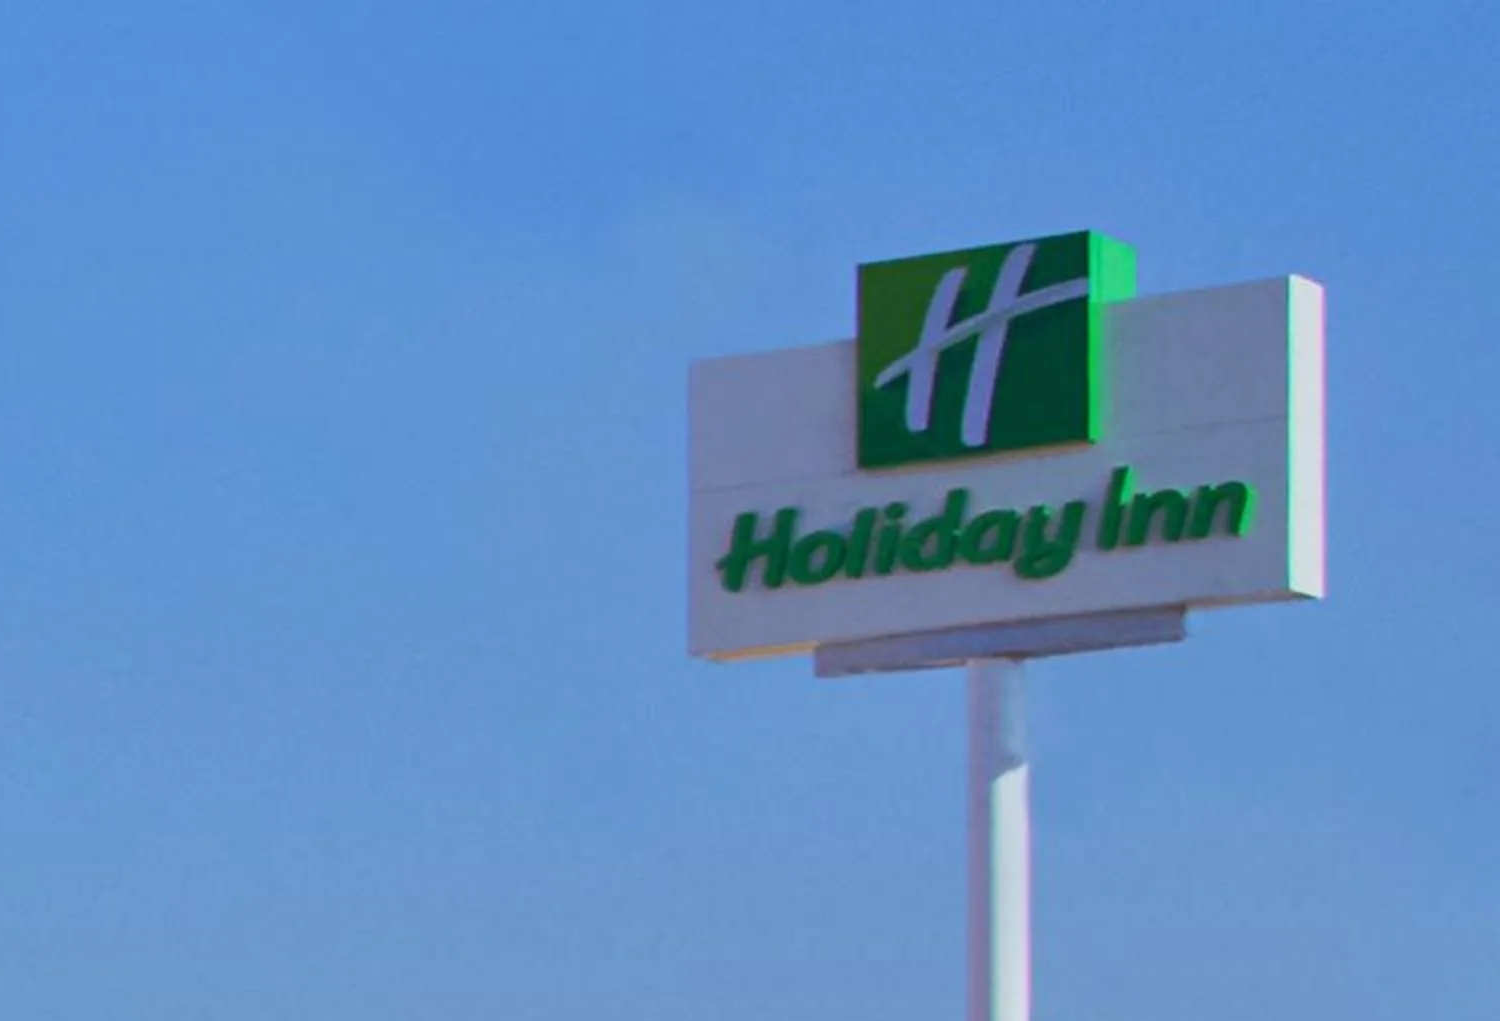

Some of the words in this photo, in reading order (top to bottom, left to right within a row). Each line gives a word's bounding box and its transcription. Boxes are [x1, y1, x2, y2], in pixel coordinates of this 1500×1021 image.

[874, 243, 1090, 447] H
[716, 487, 1088, 592] Holiday
[1094, 464, 1258, 552] Inn
